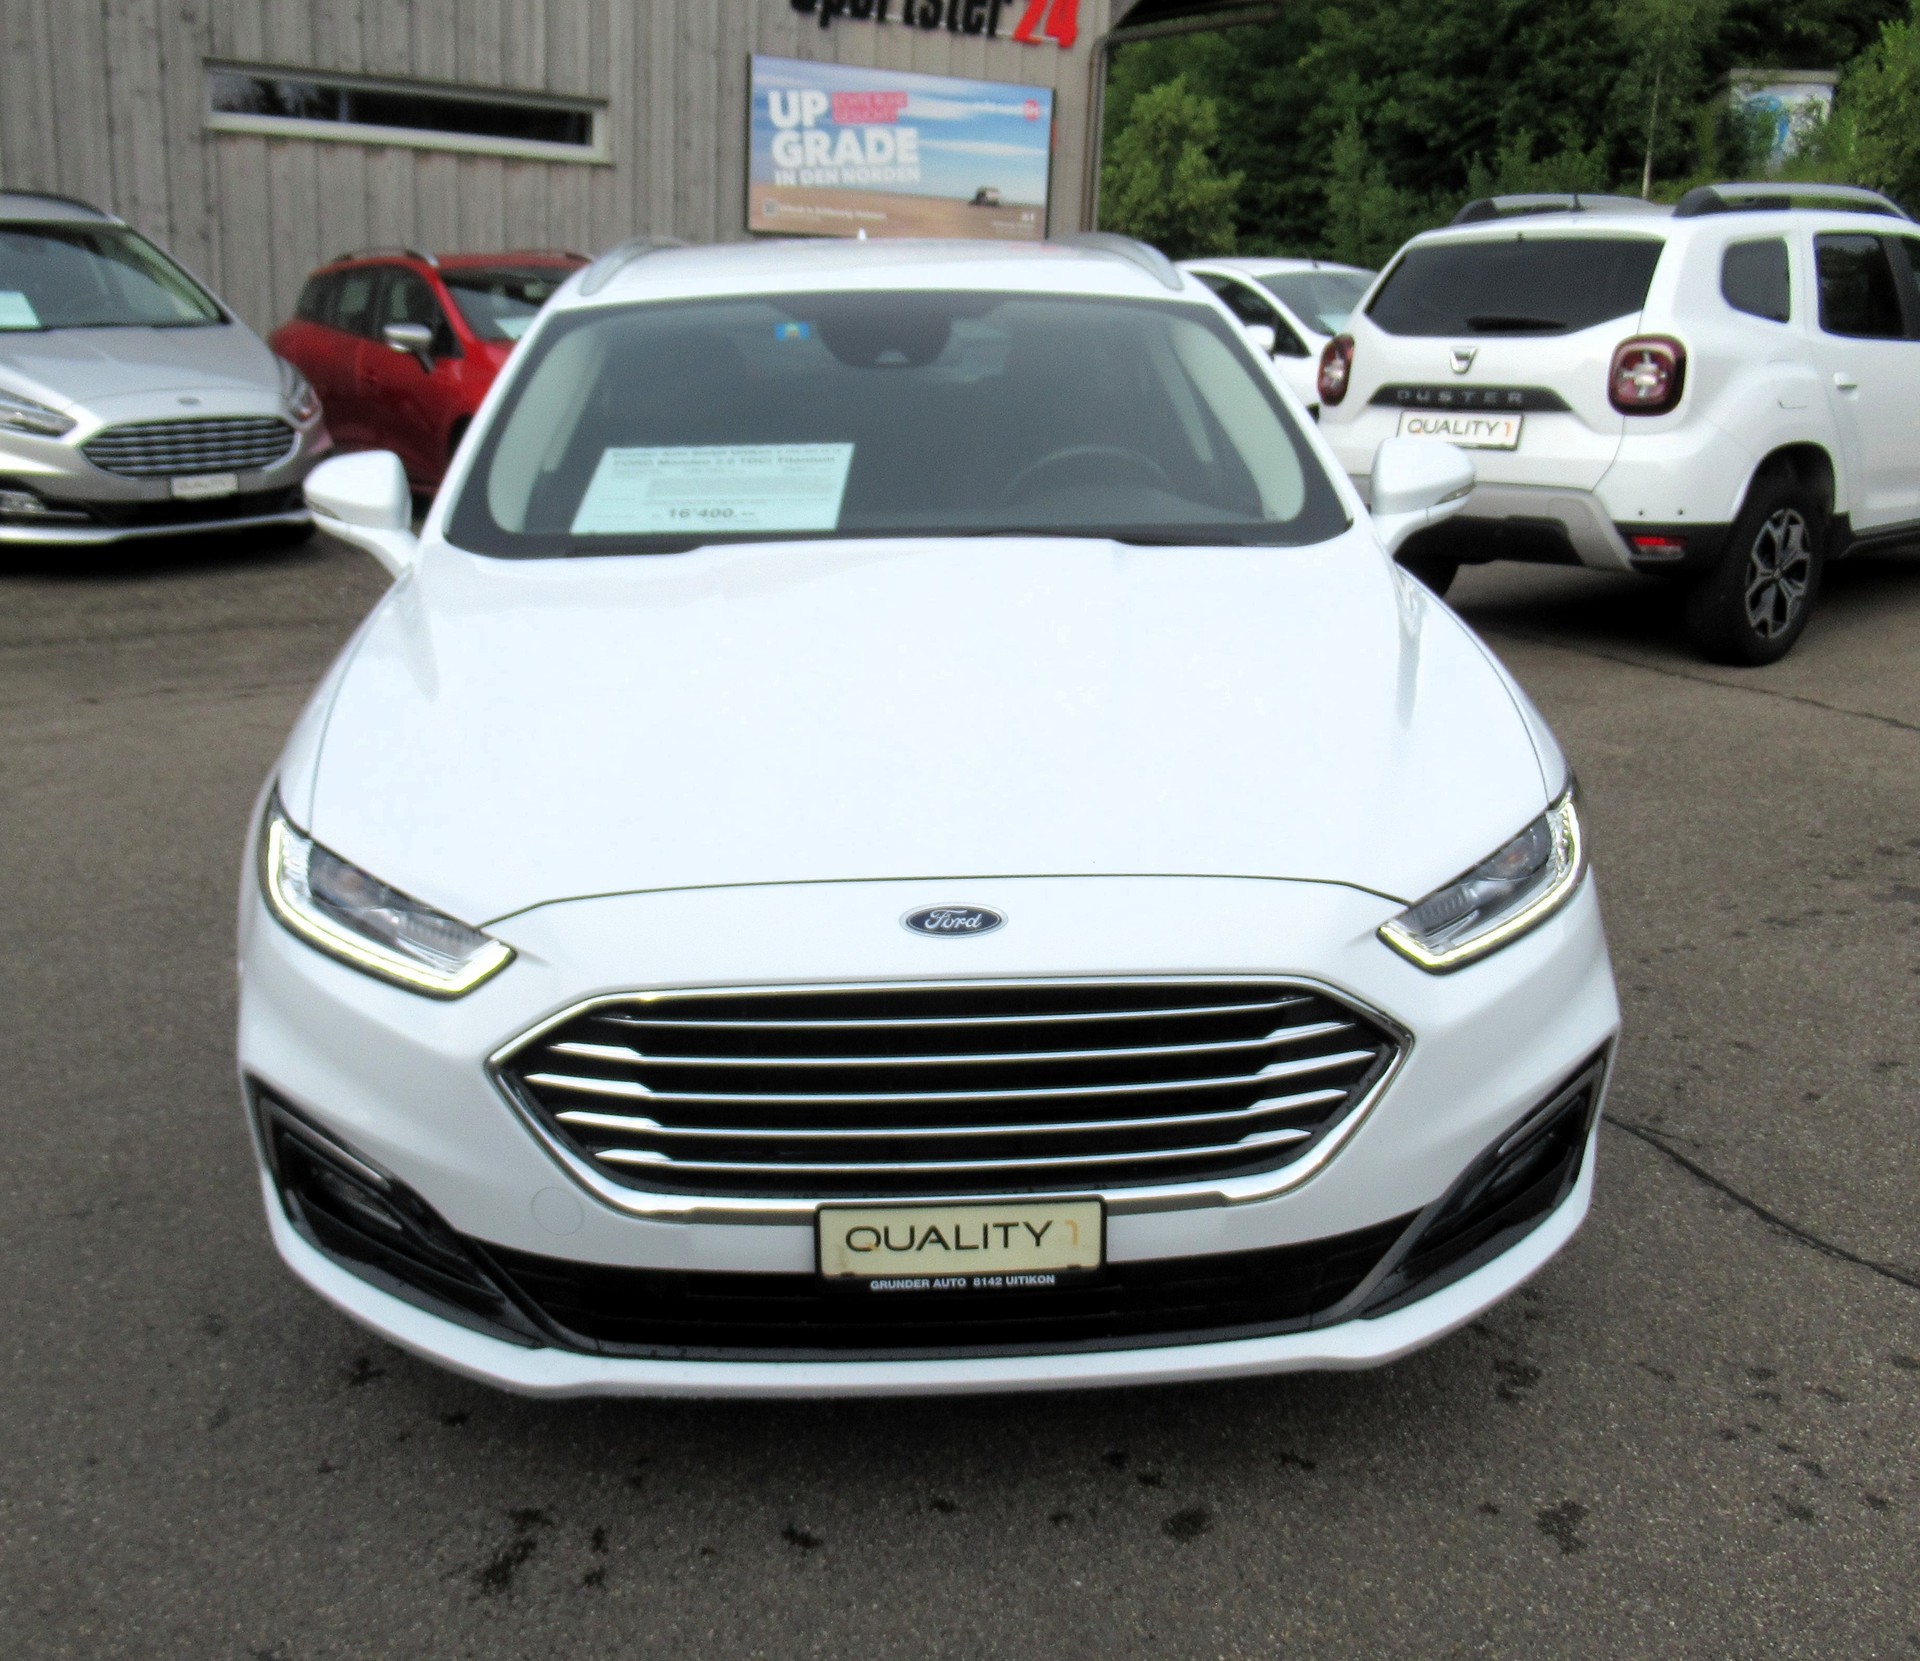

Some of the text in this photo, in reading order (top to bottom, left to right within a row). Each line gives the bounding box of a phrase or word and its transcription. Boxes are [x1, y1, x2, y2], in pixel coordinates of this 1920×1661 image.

[768, 90, 829, 129] UP
[771, 127, 918, 168] GRADE
[774, 169, 797, 186] IN
[800, 167, 840, 185] DEN
[1396, 389, 1523, 404] DUSTER
[1407, 418, 1513, 437] QUALITY 1
[924, 909, 982, 930] Ford
[845, 1220, 1053, 1253] QUALITY
[870, 1274, 1056, 1290] GRUNDER AUTO 8142 UITIKON
